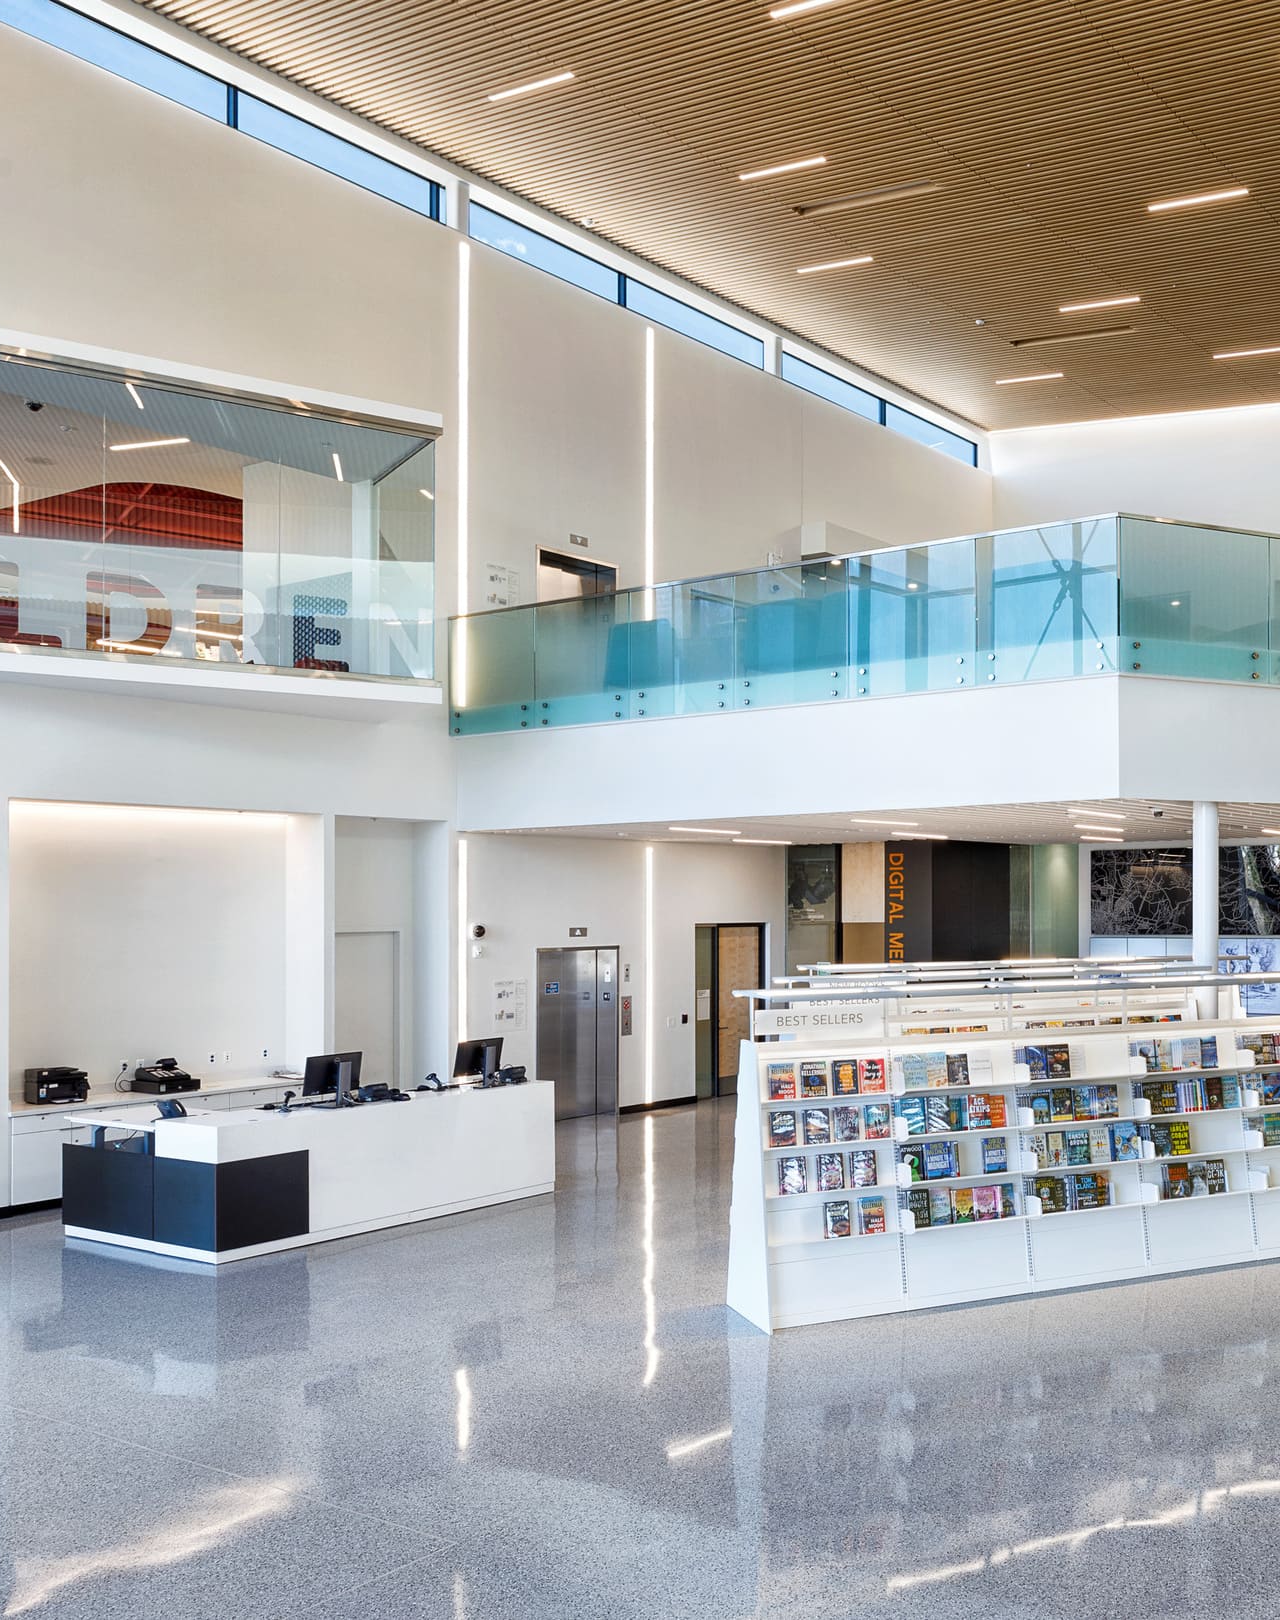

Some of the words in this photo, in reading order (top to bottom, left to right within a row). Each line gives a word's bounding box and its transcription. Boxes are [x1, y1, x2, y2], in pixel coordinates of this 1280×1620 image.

[889, 853, 904, 924] DIGITAL
[776, 1015, 808, 1027] BEST
[812, 1013, 863, 1026] SELLERS
[900, 1145, 922, 1153] ATWOOD
[1075, 1182, 1097, 1190] CLANCY
